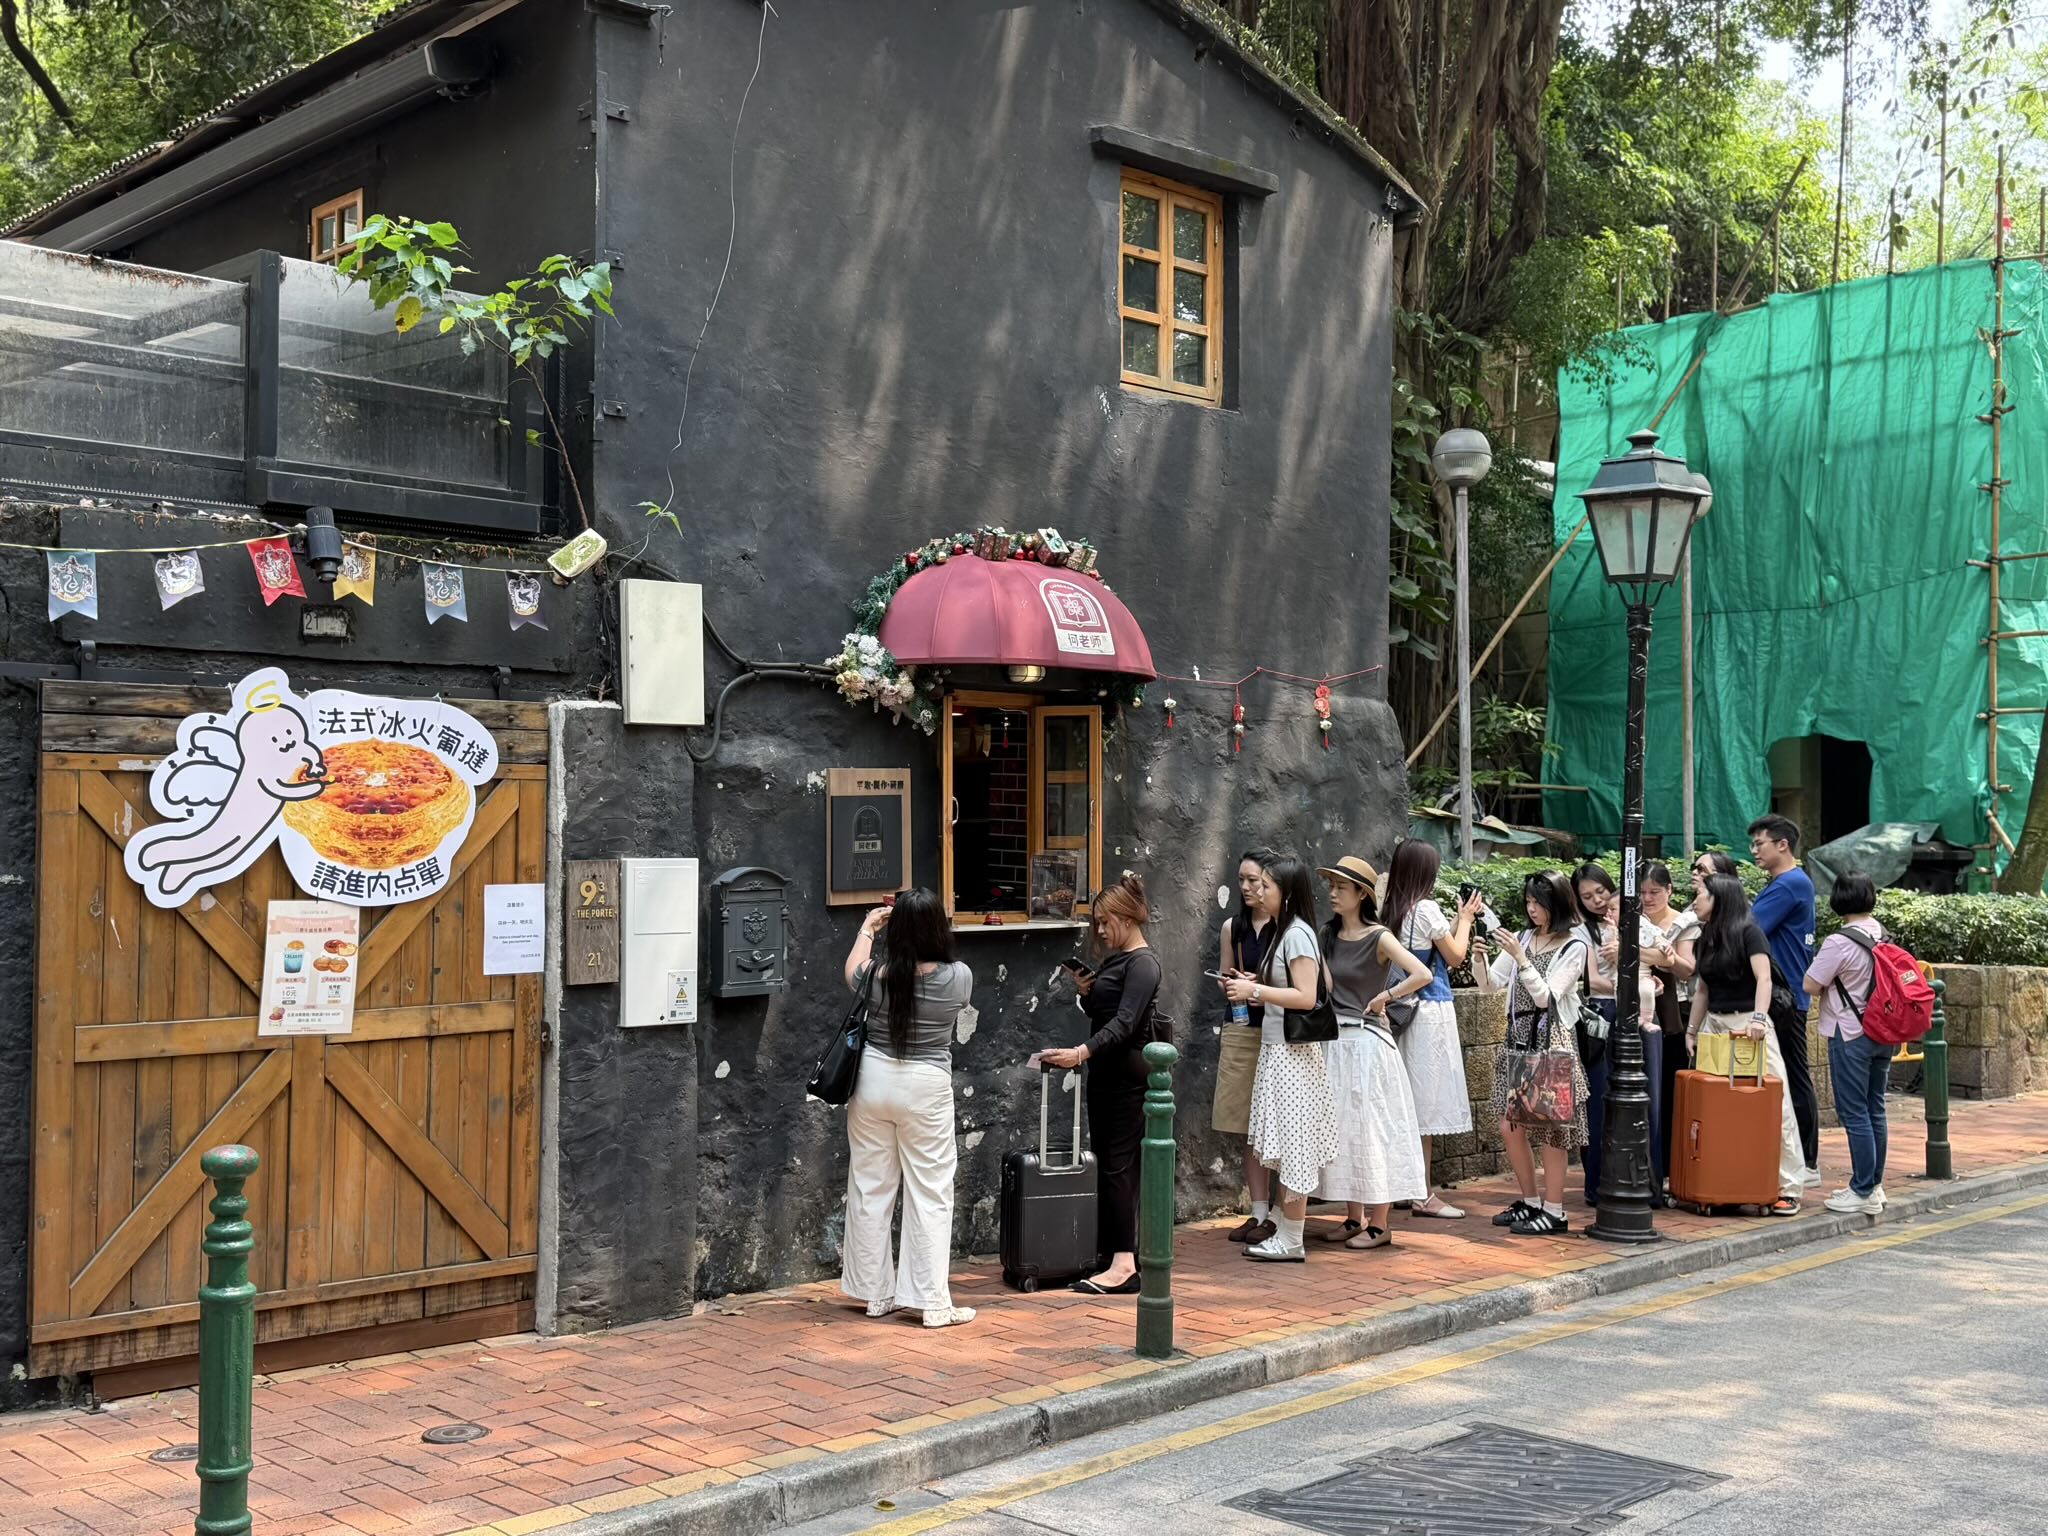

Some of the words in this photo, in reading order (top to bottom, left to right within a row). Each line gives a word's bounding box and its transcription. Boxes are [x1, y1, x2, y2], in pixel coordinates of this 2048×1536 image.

[305, 612, 319, 630] 21
[318, 707, 490, 775] 法式冰火葡撻
[580, 880, 597, 906] 9
[577, 909, 590, 919] THE
[591, 908, 613, 918] PORTE
[588, 952, 601, 966] 21
